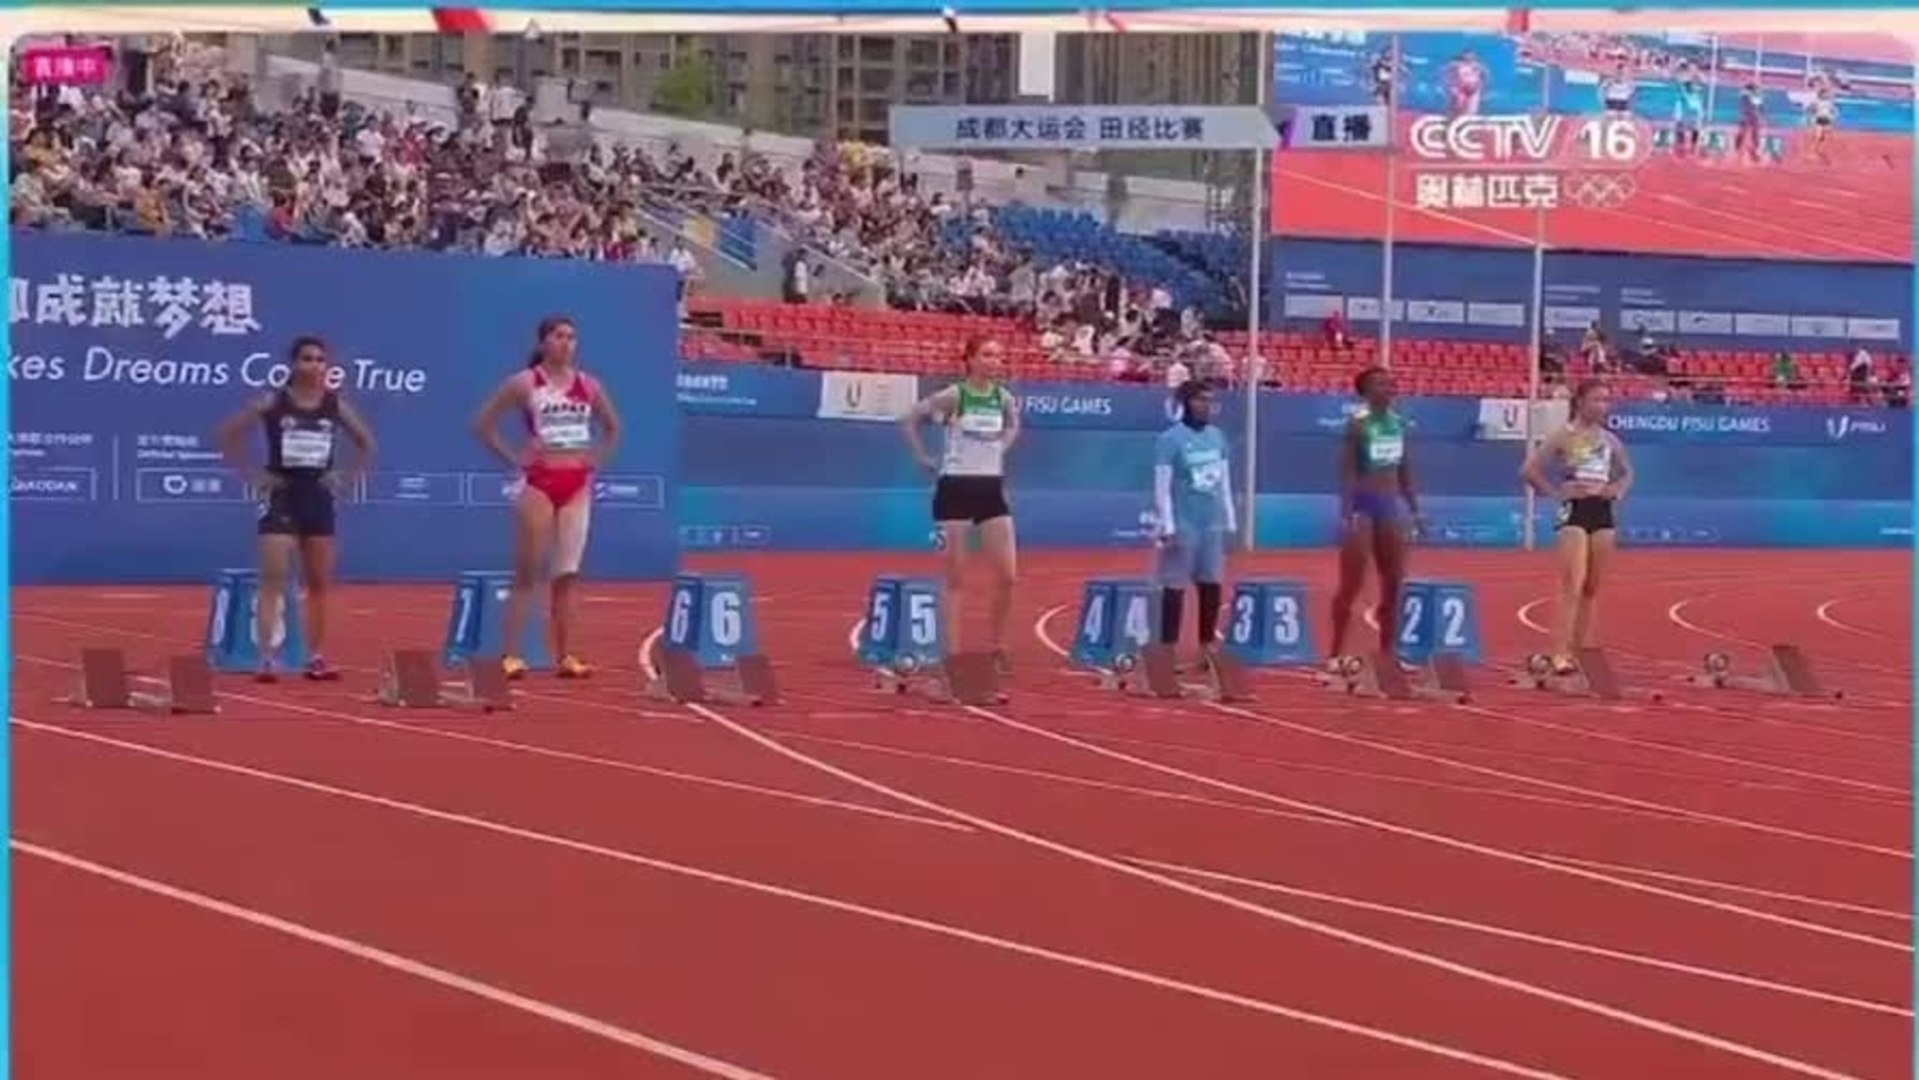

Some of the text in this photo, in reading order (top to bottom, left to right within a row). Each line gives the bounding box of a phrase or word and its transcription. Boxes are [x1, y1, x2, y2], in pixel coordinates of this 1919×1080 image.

[84, 346, 229, 385] Dreams
[241, 352, 345, 388] Coe
[354, 358, 427, 393] True
[1061, 396, 1112, 414] GAMES
[1718, 415, 1771, 432] GAMES
[670, 589, 690, 643] 6
[711, 592, 741, 646] 6
[871, 591, 891, 642] 5
[911, 594, 937, 644] 5
[1084, 596, 1106, 642] 4
[1124, 596, 1150, 646] 4
[1234, 596, 1255, 644] 3
[1274, 597, 1299, 644] 3
[1402, 597, 1422, 643] 2
[1442, 597, 1469, 645] 2
